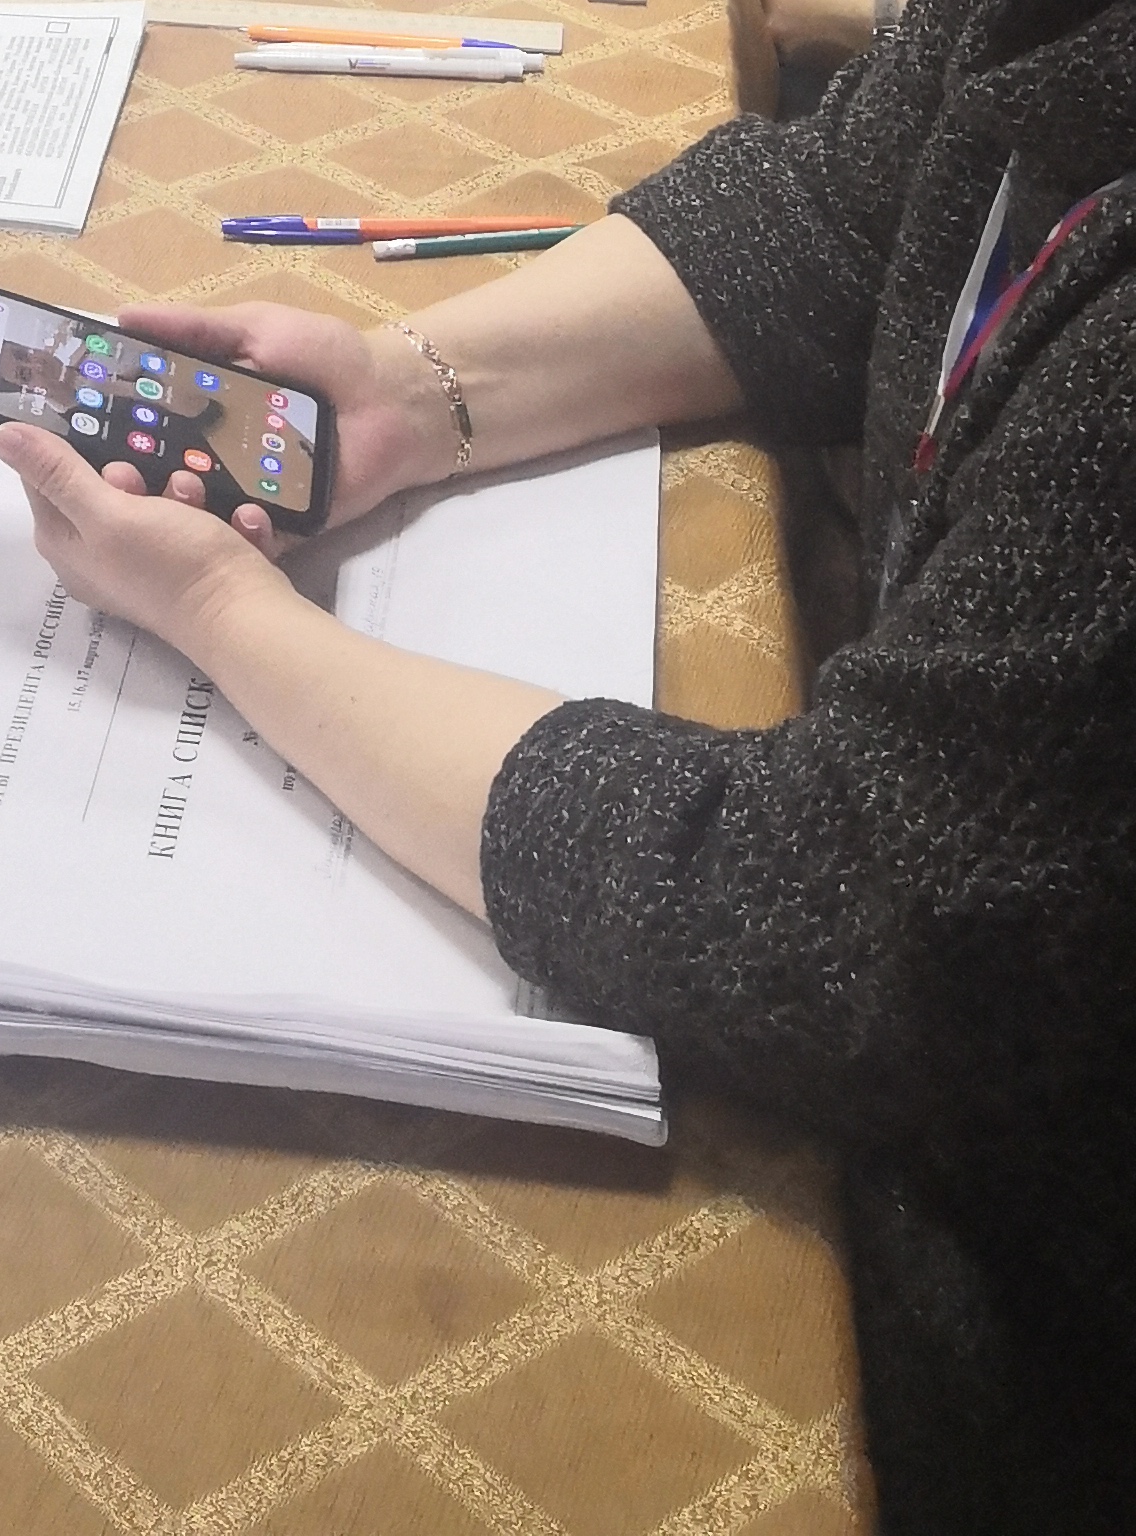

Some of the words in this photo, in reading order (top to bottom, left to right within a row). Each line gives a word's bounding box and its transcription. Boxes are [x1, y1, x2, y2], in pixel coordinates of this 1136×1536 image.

[0, 665, 45, 764] ПРЕЗИДЕНТА
[77, 670, 91, 683] 17
[148, 774, 193, 859] КНИГА
[172, 677, 214, 762] СПИСК
